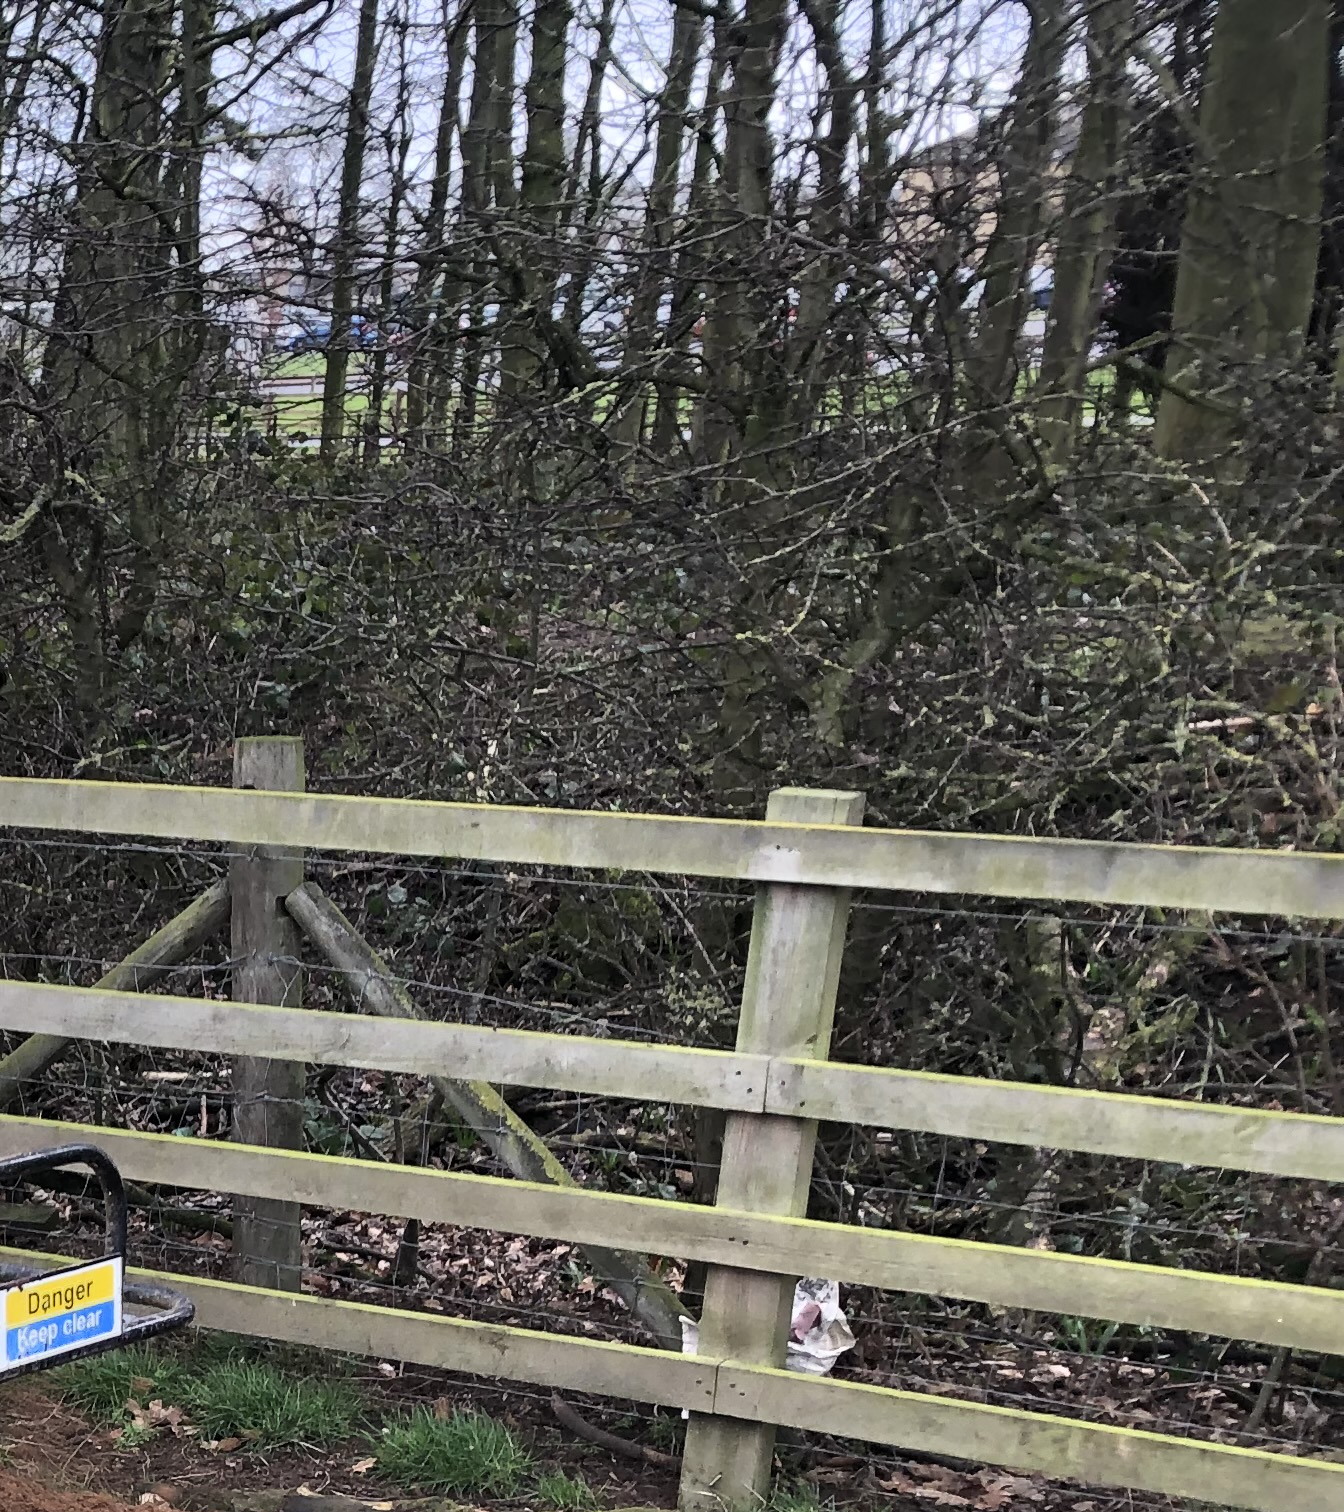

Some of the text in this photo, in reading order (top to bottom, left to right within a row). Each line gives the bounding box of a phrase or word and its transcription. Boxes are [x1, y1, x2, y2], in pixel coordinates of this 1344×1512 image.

[28, 1280, 94, 1315] Danger
[17, 1309, 102, 1350] Keep clear
